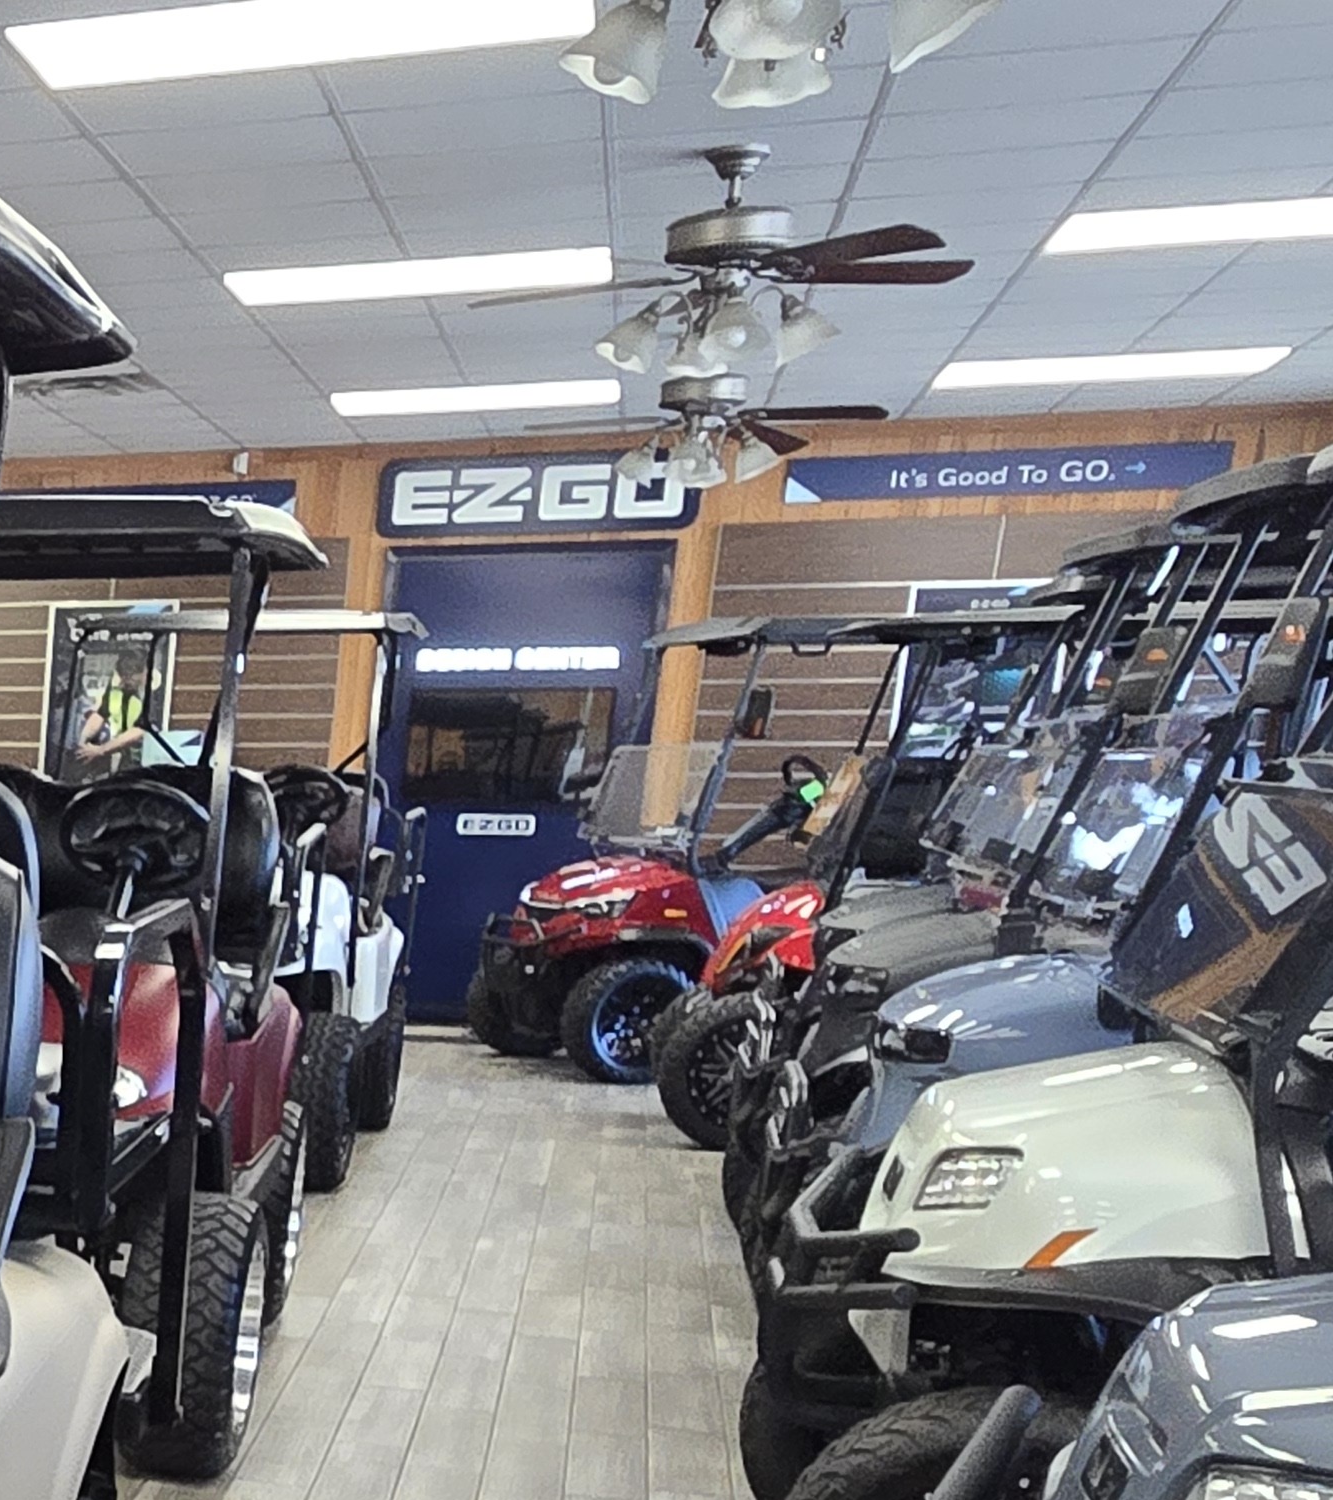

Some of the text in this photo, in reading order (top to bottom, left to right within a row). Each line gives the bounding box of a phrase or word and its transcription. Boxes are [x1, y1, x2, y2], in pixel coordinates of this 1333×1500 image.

[391, 463, 685, 526] EZGO
[889, 460, 1115, 488] It's Good To GO.
